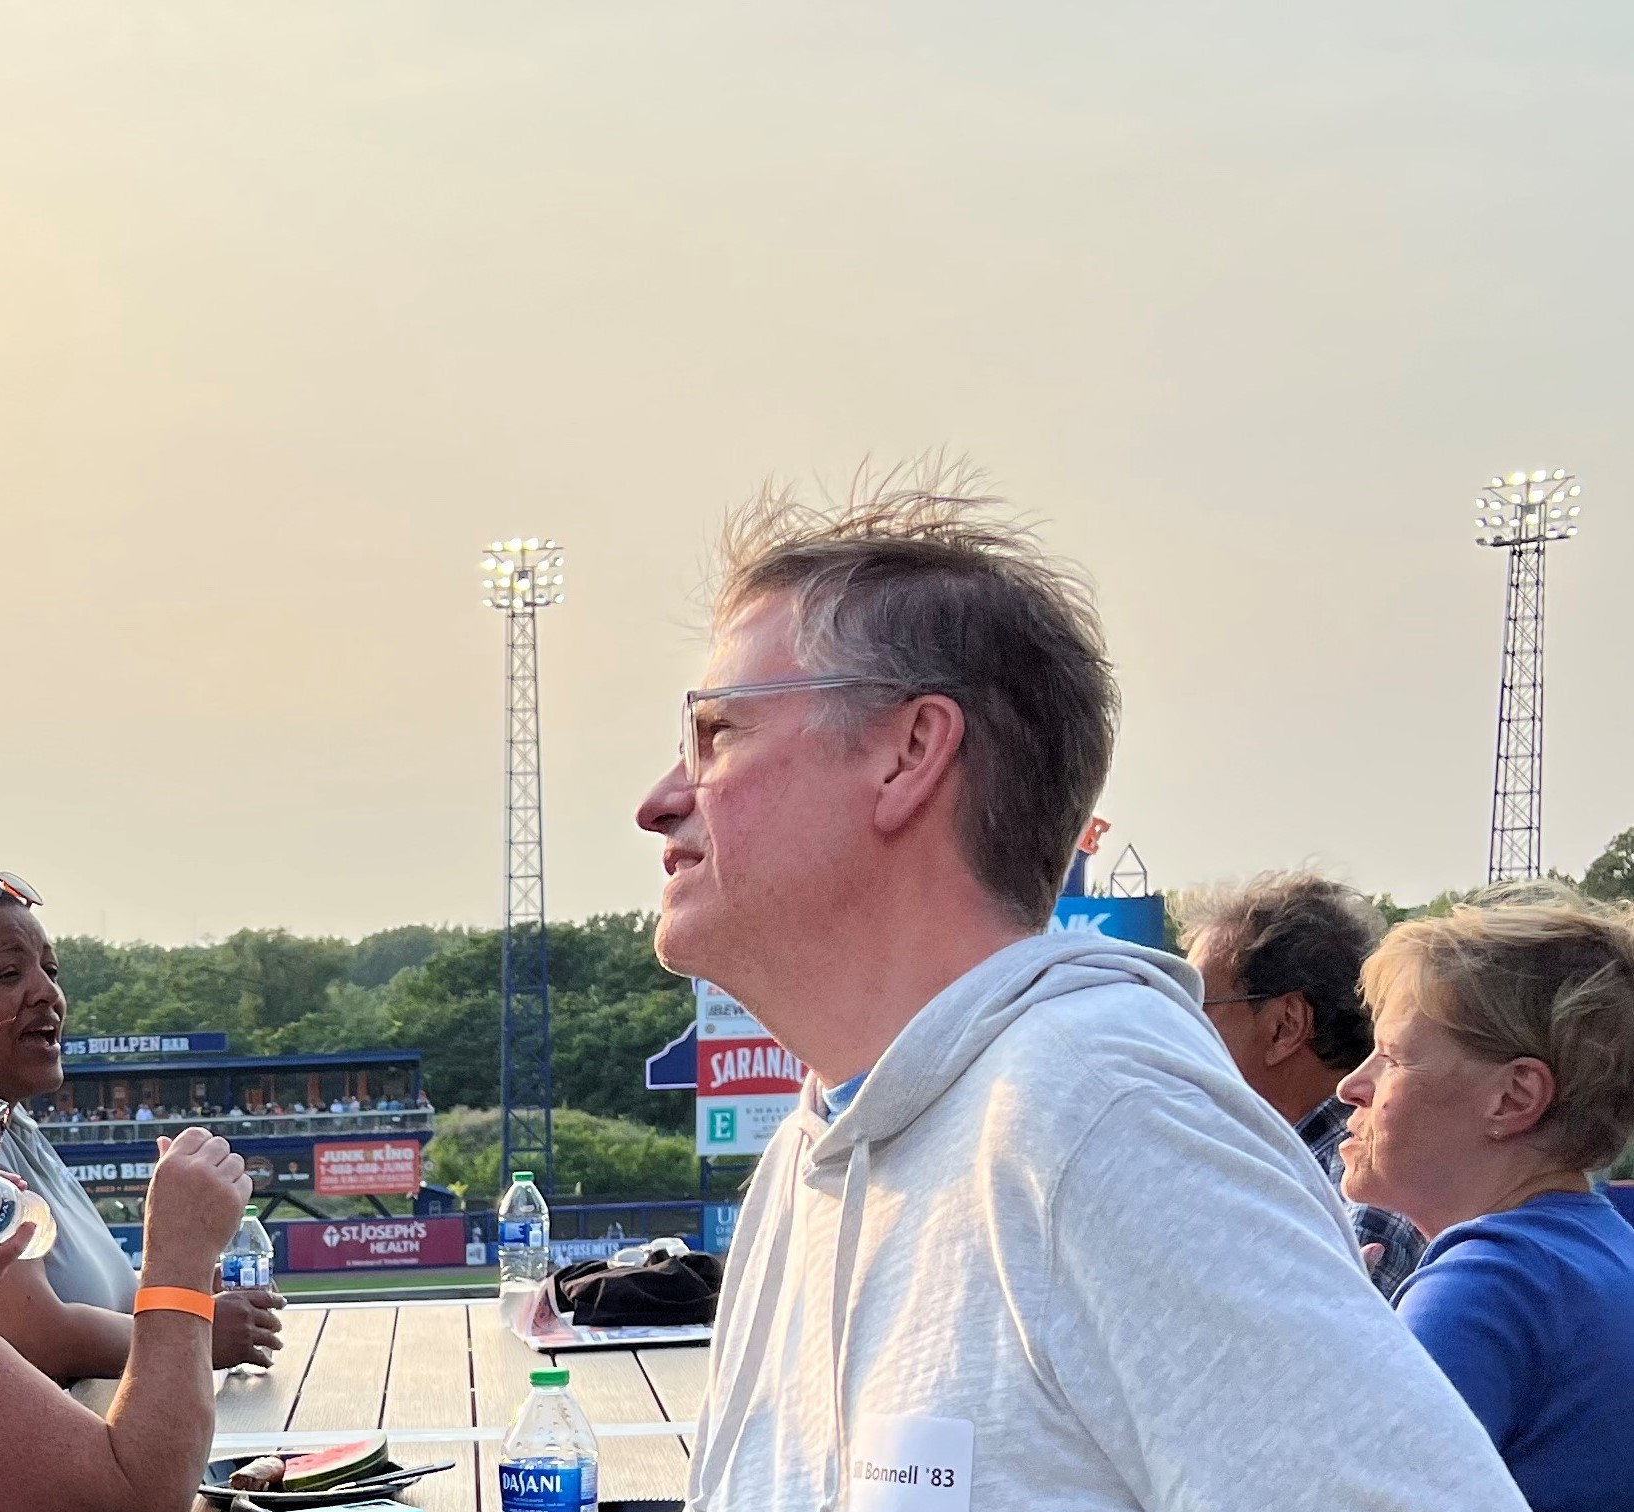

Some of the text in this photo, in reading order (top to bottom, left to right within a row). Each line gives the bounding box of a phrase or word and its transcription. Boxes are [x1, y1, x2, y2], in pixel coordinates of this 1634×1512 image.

[88, 1035, 161, 1054] BULLPEN
[162, 1037, 190, 1051] BAR
[320, 1149, 364, 1163] JUNK
[360, 1221, 428, 1244] JOSEPH'S
[370, 1240, 420, 1254] HEALTH
[502, 1471, 562, 1497] DASANI
[865, 1462, 918, 1485] Bonnell
[926, 1466, 955, 1488] '83
